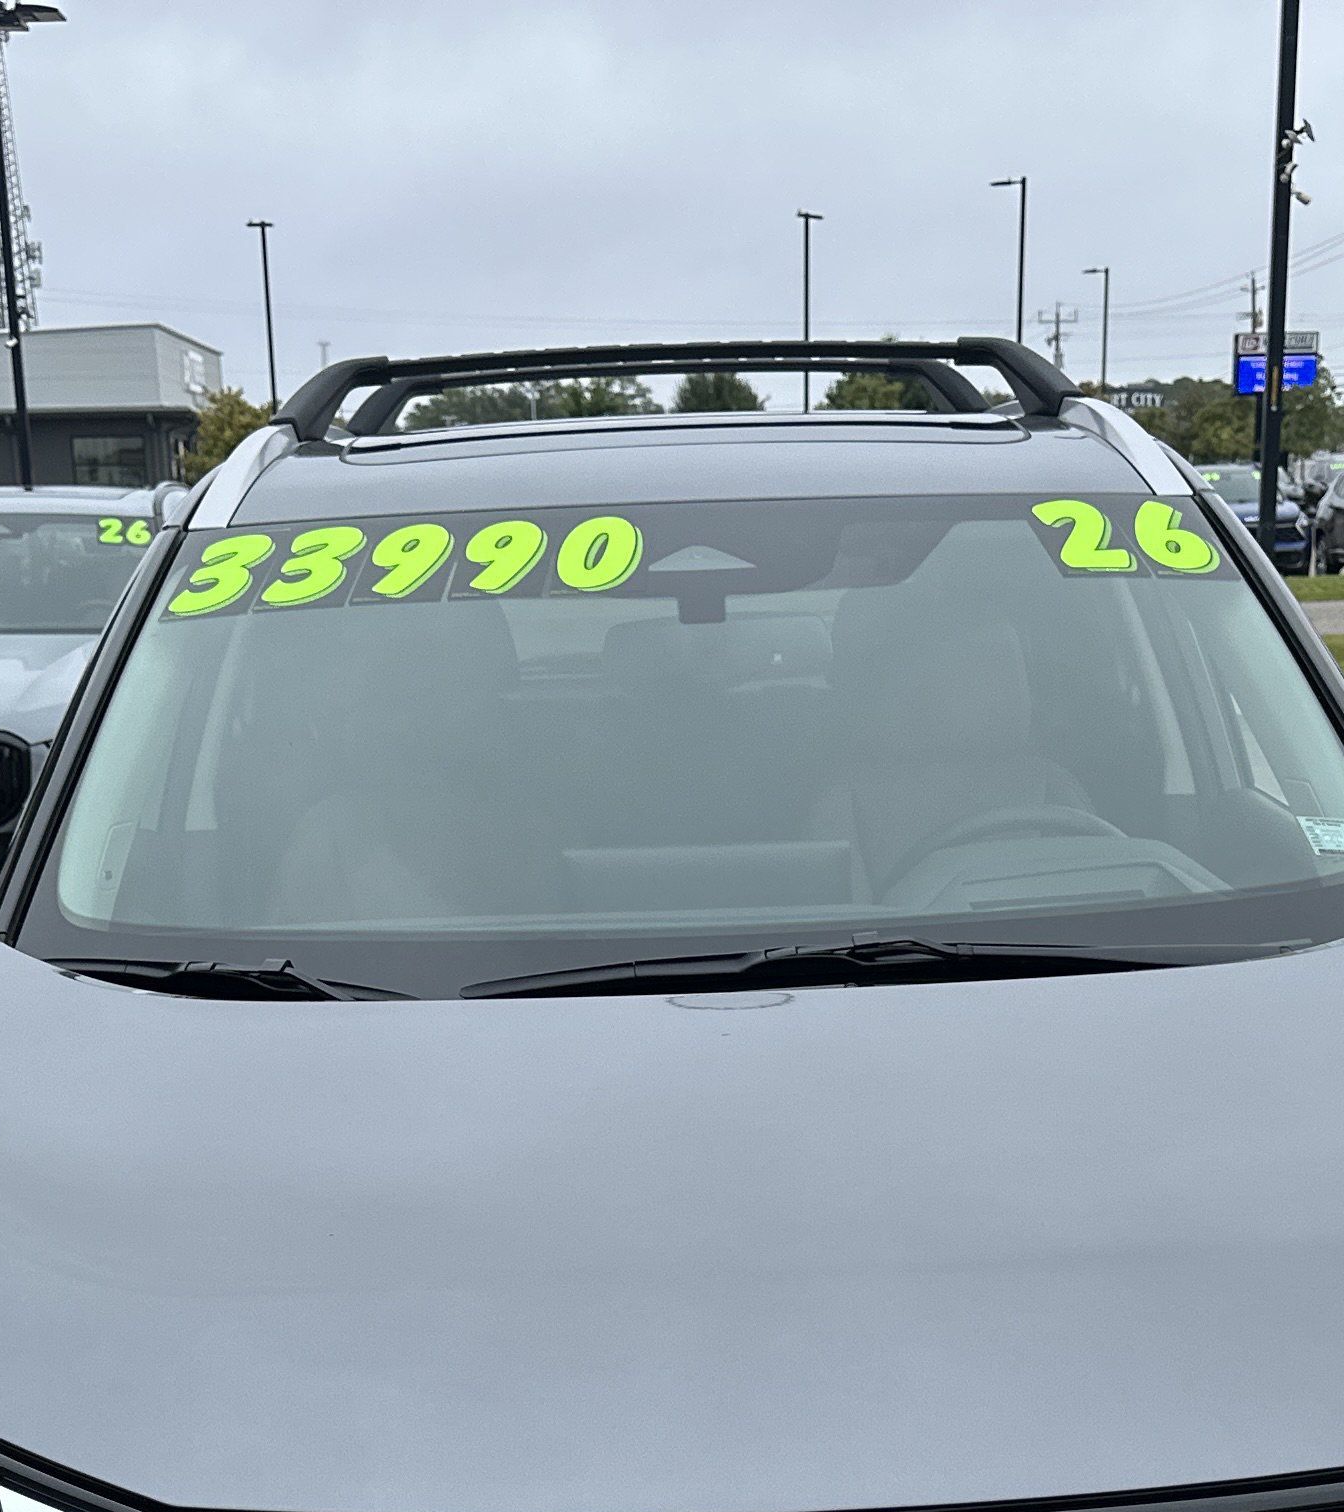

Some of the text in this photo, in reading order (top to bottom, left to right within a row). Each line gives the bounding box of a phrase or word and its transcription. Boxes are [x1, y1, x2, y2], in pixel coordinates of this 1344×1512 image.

[98, 518, 151, 545] 26
[168, 500, 1221, 617] 33990 26
